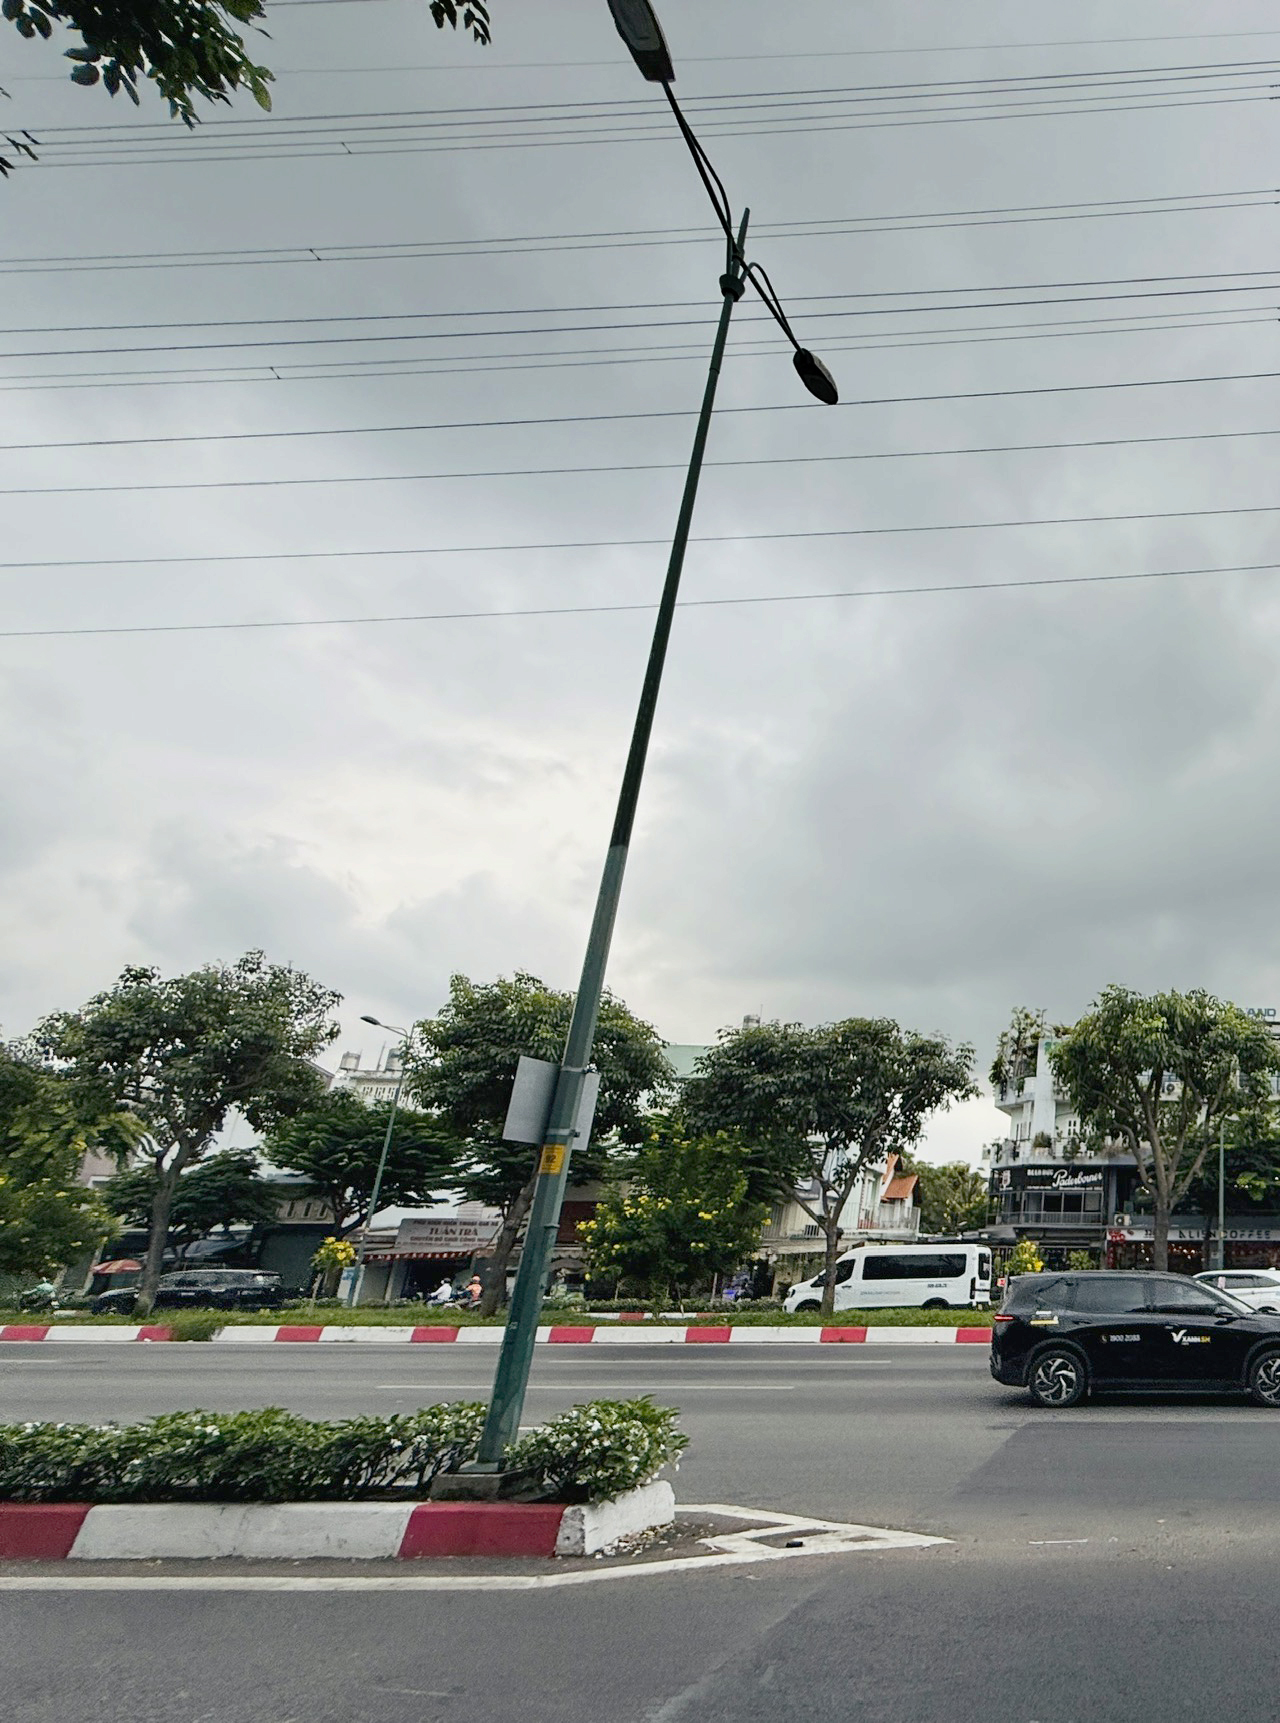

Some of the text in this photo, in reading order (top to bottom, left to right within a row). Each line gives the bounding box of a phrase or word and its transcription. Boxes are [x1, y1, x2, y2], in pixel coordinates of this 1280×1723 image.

[1052, 1169, 1103, 1187] Paderborner
[1179, 1230, 1271, 1239] ALIEN COFFEE
